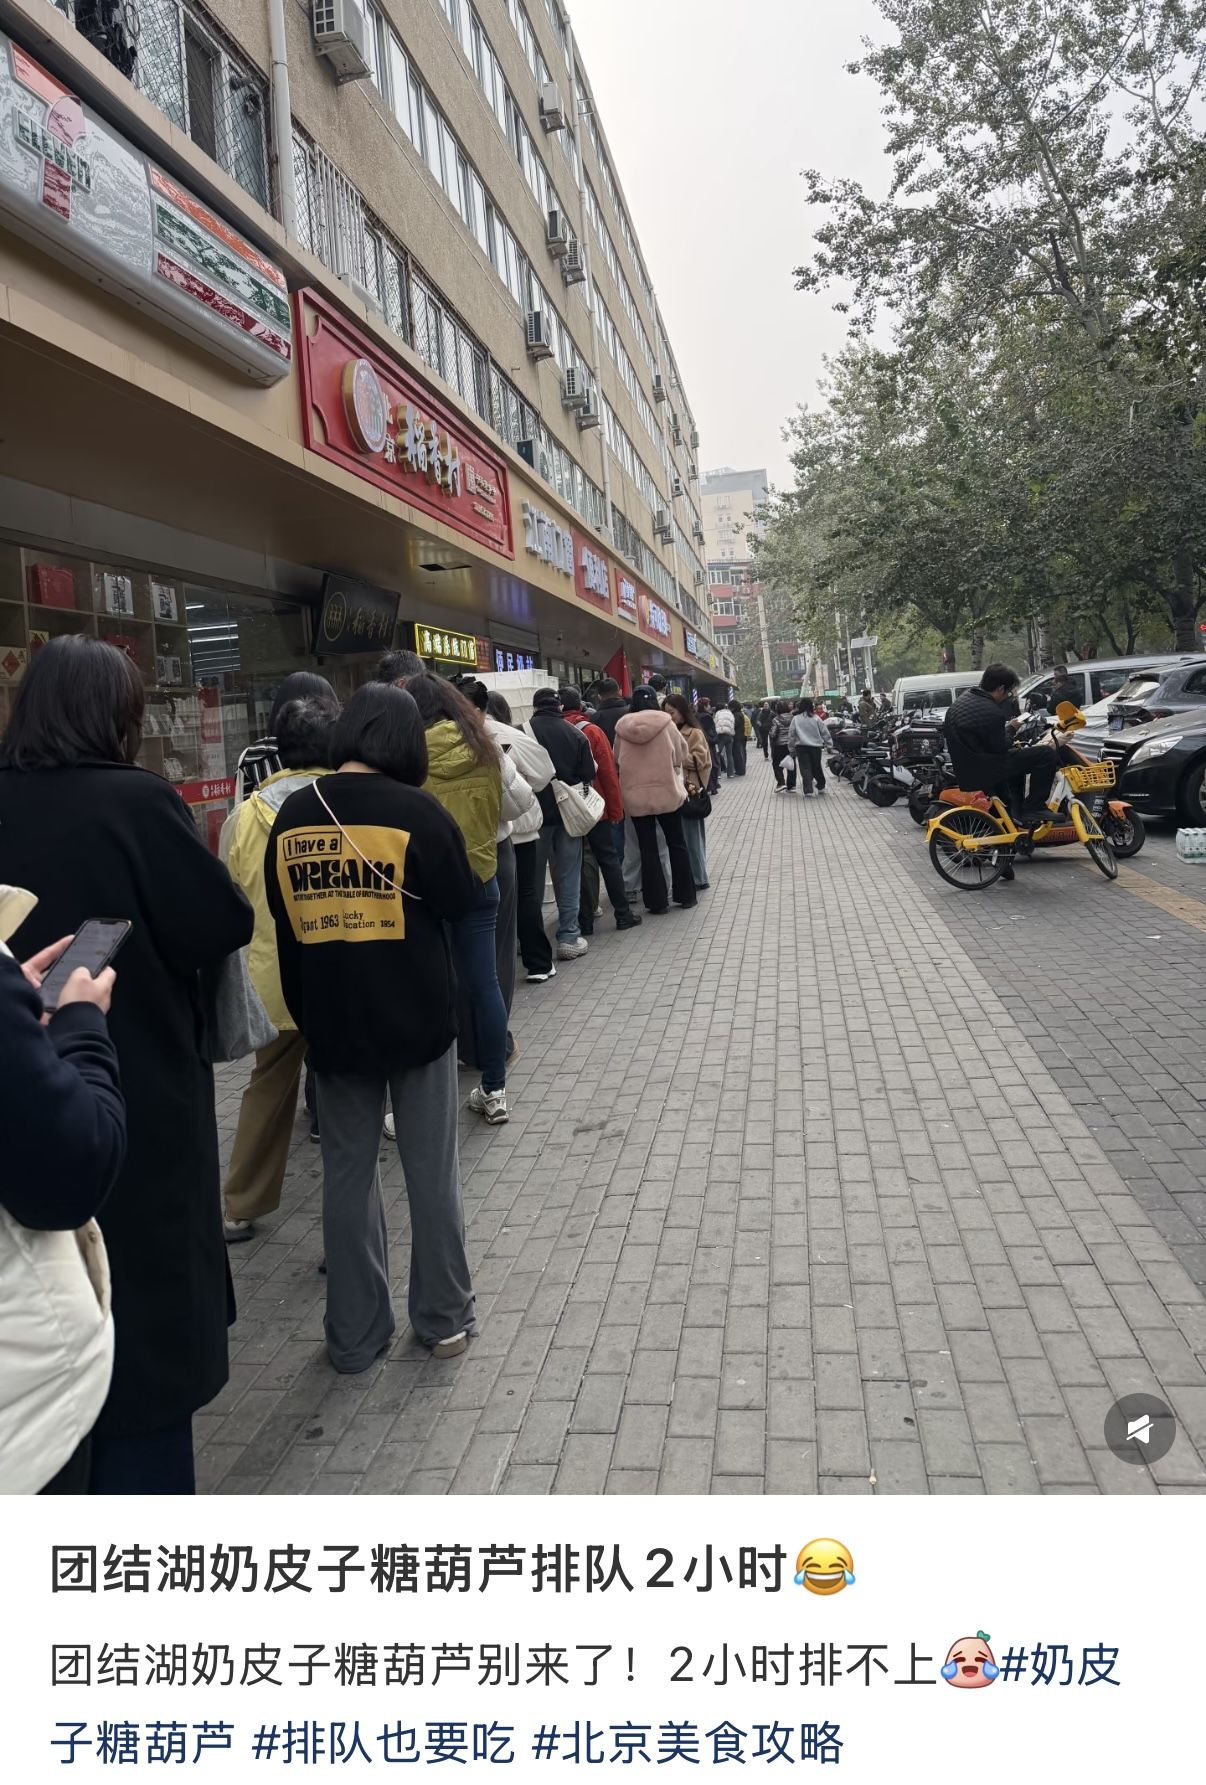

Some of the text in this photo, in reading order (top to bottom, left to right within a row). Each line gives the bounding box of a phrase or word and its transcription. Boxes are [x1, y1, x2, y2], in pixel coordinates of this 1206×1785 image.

[287, 838, 339, 856] I have a
[287, 859, 395, 893] DREAM
[320, 914, 340, 931] 1963
